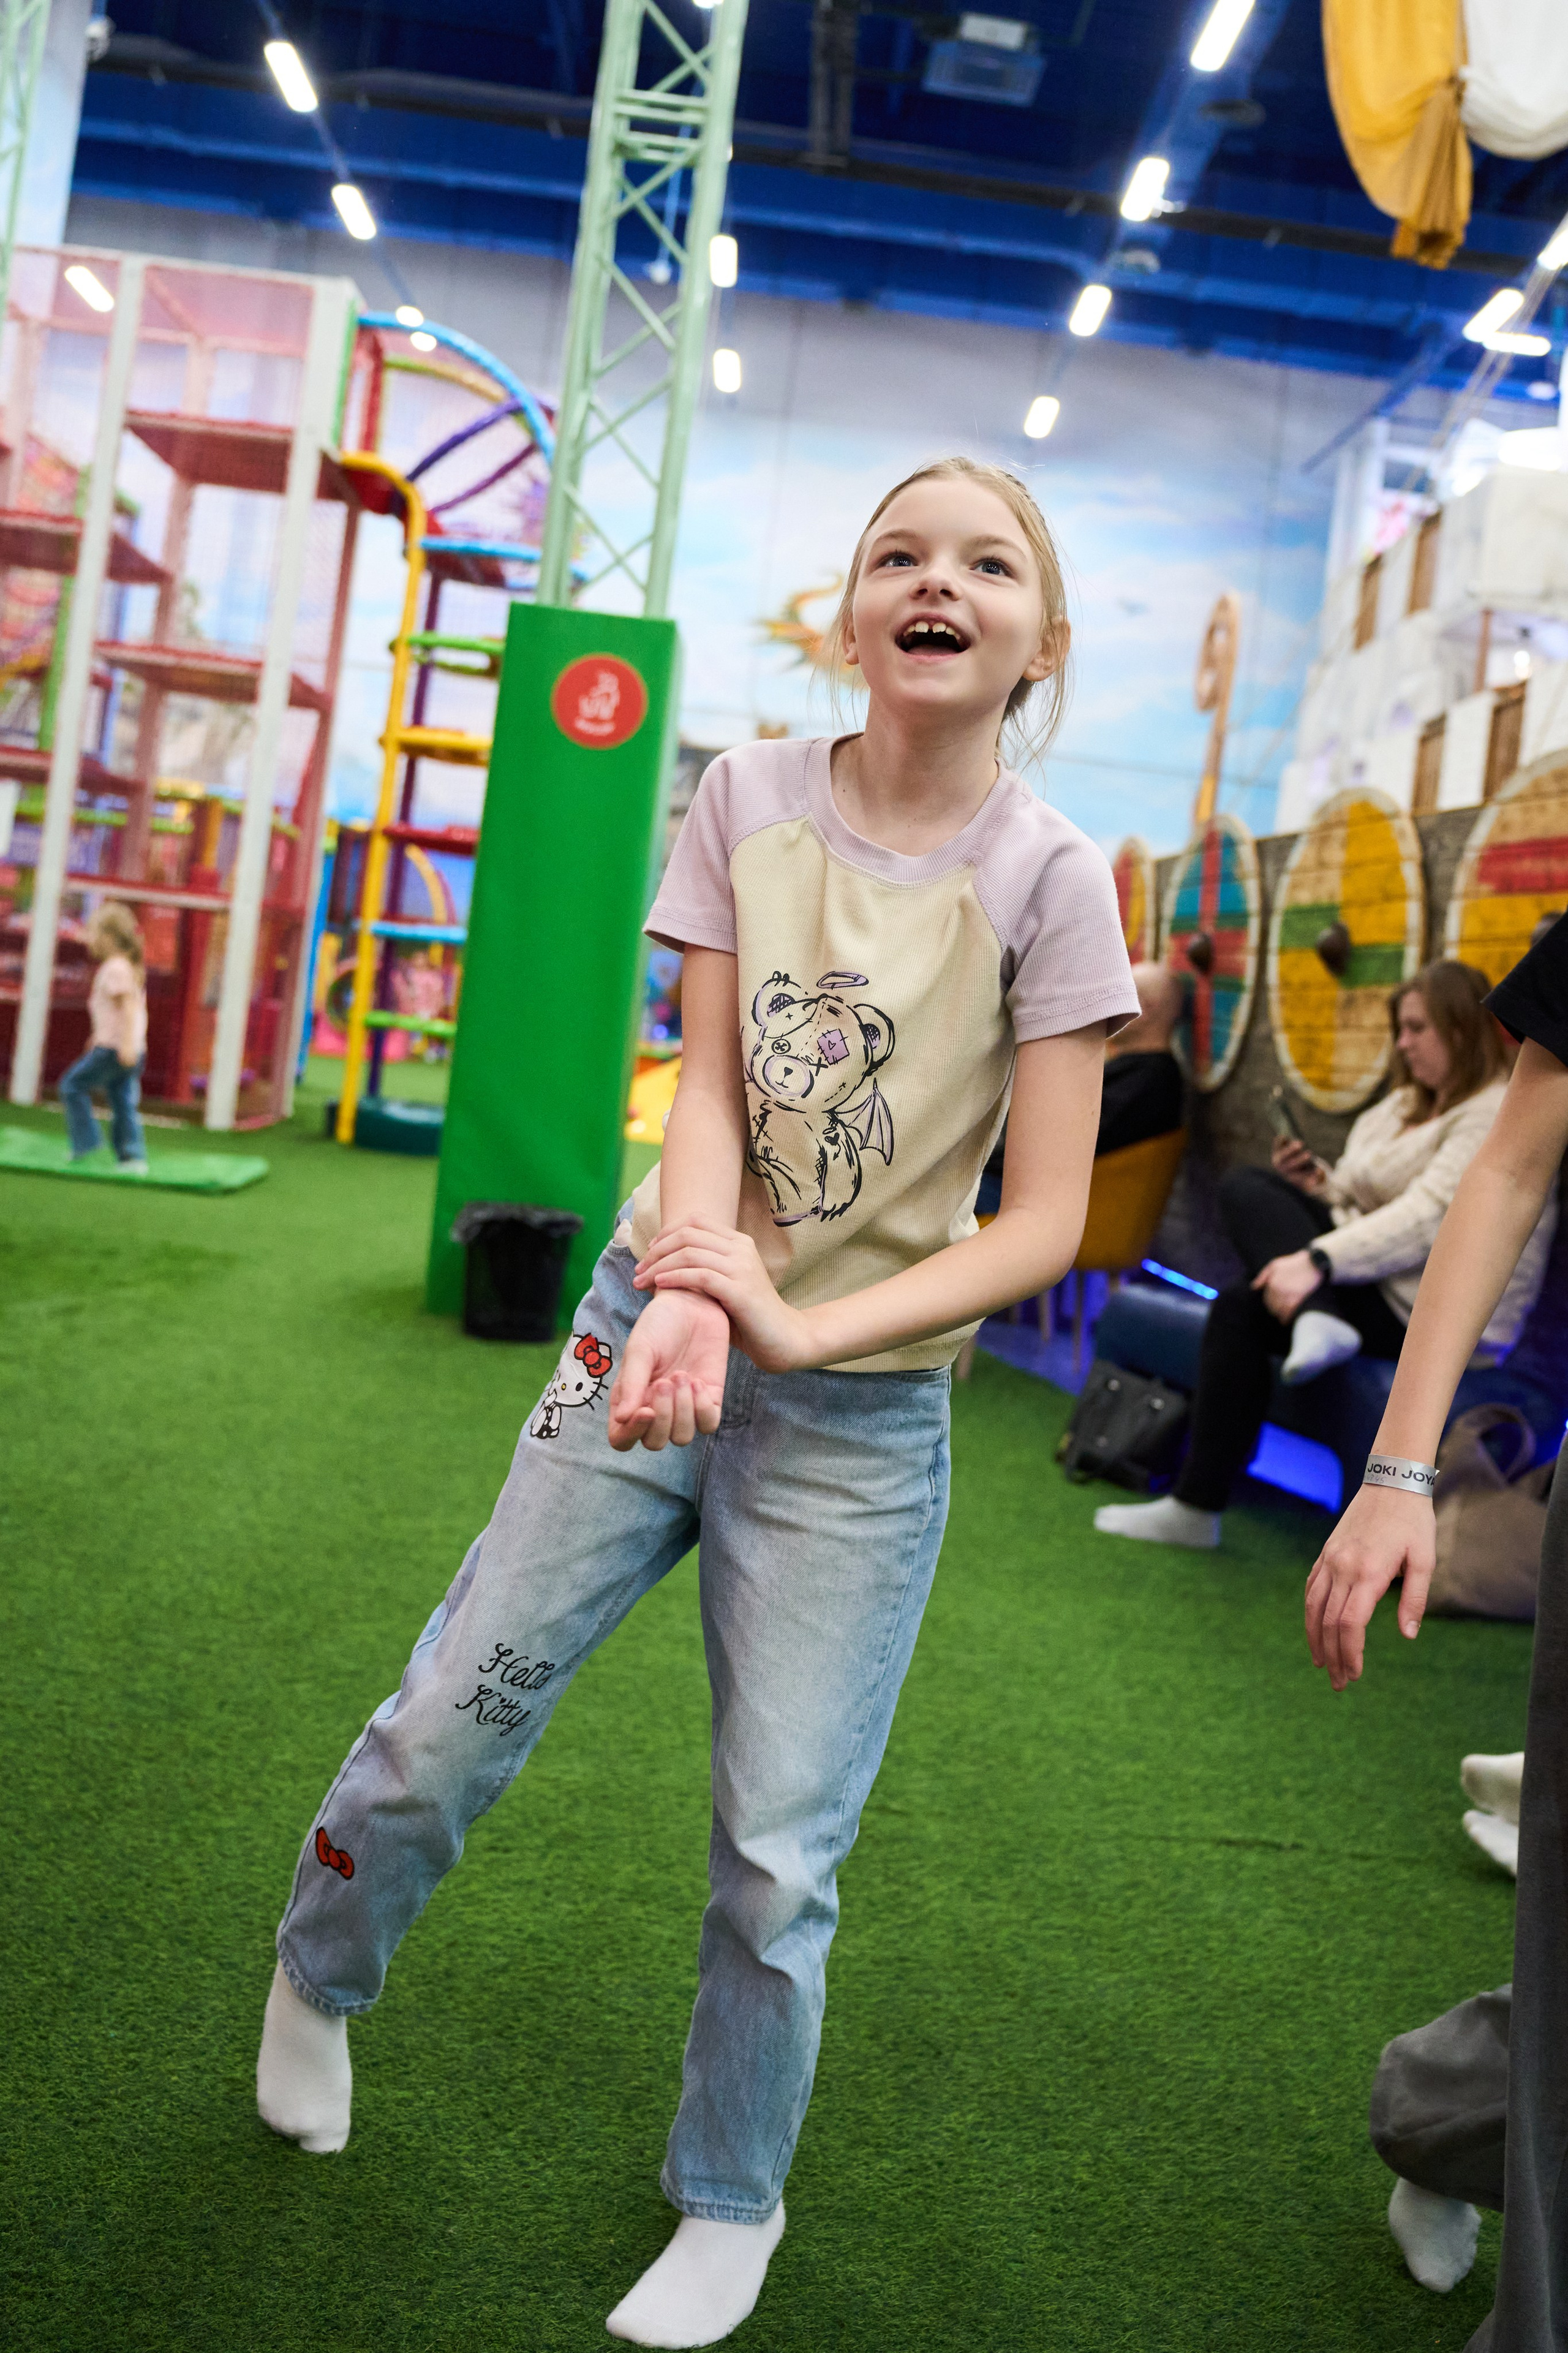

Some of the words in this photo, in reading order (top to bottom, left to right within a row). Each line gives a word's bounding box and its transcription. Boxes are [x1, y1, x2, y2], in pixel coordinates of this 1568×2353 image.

[1367, 1463, 1396, 1476] JOKI
[478, 1643, 555, 1690] Hello
[455, 1685, 531, 1736] Kitty
